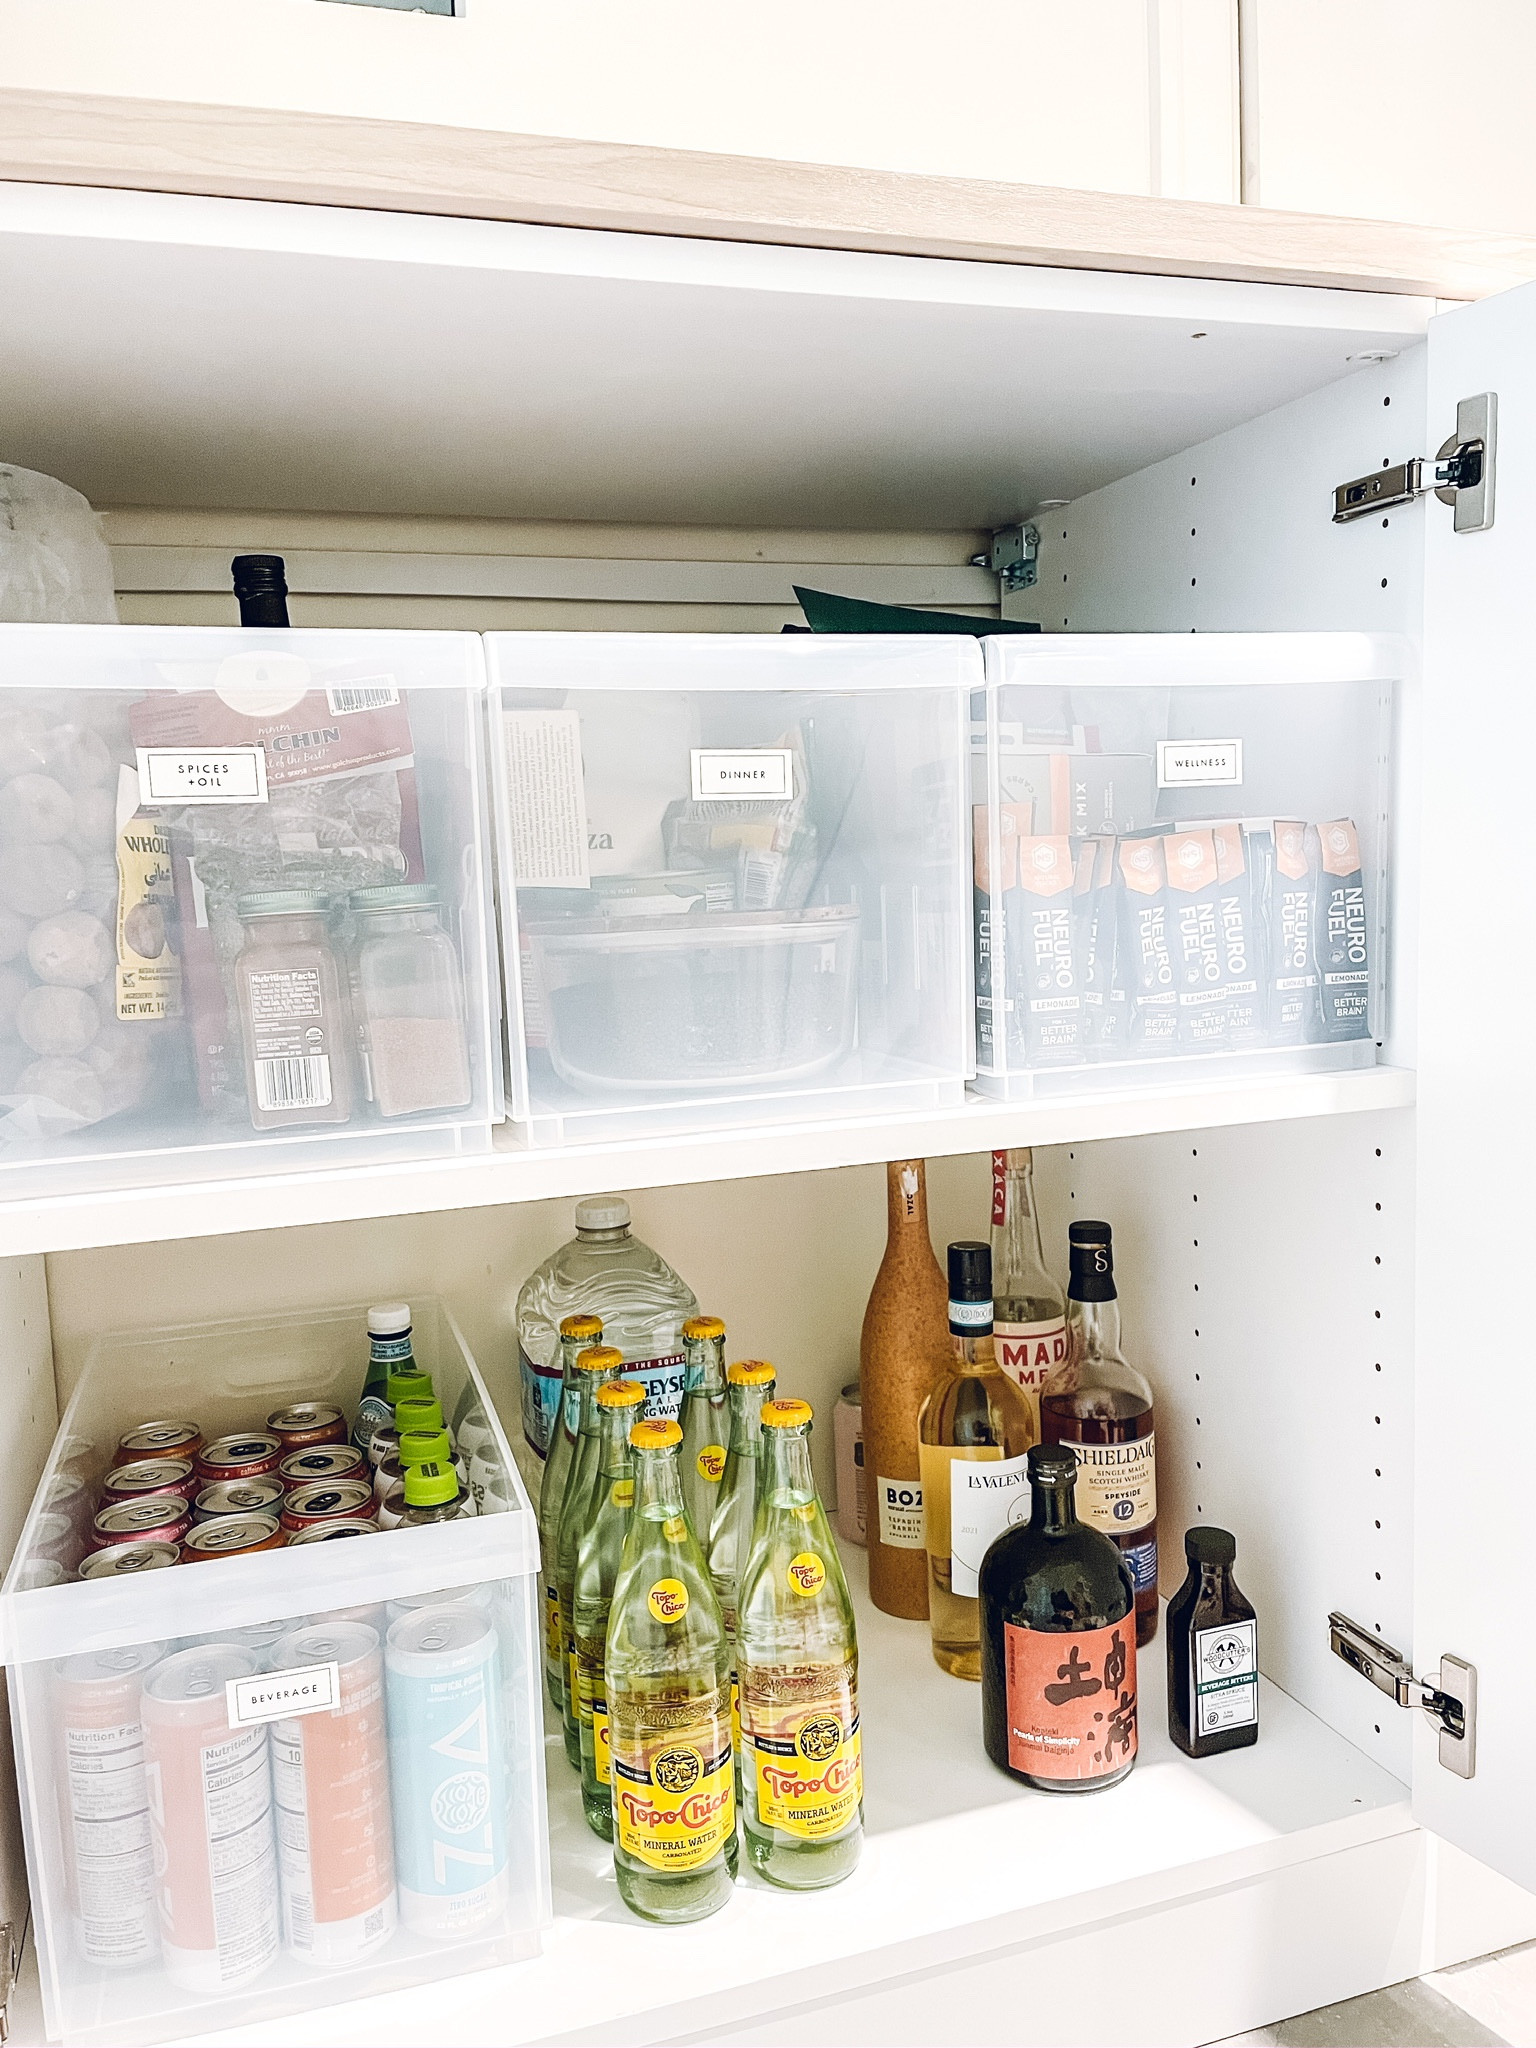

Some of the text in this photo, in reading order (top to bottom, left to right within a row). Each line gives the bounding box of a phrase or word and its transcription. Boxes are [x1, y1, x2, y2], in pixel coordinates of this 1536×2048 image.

[233, 727, 341, 753] LCHIN
[178, 764, 230, 774] SPICES
[1175, 759, 1226, 767] WELLNESS
[188, 777, 222, 787] +OIL
[720, 770, 766, 779] DINNER
[1075, 782, 1087, 817] MIX
[1281, 892, 1295, 947] FUEL
[1328, 889, 1345, 943] FUEL
[1179, 906, 1201, 962] FUEL
[1295, 892, 1308, 968] NEURO
[1346, 888, 1367, 963] NEURO
[1032, 911, 1054, 966] FUEL
[1139, 909, 1155, 965] FUEL
[1197, 903, 1220, 981] NEURO
[1221, 897, 1247, 974] NEURO
[1051, 909, 1073, 988] NEURO
[1152, 906, 1172, 984] NEURO
[251, 971, 317, 983] Nutrition Facts
[1226, 984, 1253, 993] ONADE
[121, 1003, 137, 1014] NET
[139, 1003, 154, 1013] WT.
[1037, 999, 1077, 1009] LEMONADE
[1334, 997, 1367, 1007] BETTER
[1227, 1008, 1253, 1018] TTER
[1041, 1025, 1077, 1035] BETTER
[1145, 1018, 1176, 1028] BETTER
[993, 1155, 1004, 1215] XACA
[1094, 1250, 1108, 1272] S
[1003, 1338, 1064, 1366] MAD
[635, 1361, 652, 1370] THE
[657, 1355, 686, 1366] SOURC
[641, 1374, 686, 1397] GEYSE
[660, 1403, 680, 1415] WAT
[700, 1455, 721, 1466] Topo
[1128, 1464, 1145, 1473] MALT
[968, 1471, 1026, 1488] LA VALENT
[1124, 1471, 1149, 1482] WHISKY
[887, 1488, 922, 1506] BOZ
[1105, 1488, 1141, 1499] SPEYSIDE
[1117, 1503, 1132, 1517] 12
[791, 1565, 816, 1579] Topo
[801, 1575, 823, 1588] Chico
[652, 1591, 678, 1605] Topo
[661, 1601, 686, 1615] Chico
[1202, 1675, 1253, 1692] BEVERAGE BITTERS
[251, 1685, 318, 1704] BEVERAGE
[69, 1732, 115, 1742] Nutrition
[1013, 1727, 1081, 1746] Pearls of Simplicity
[206, 1735, 251, 1760] Nutrition
[71, 1760, 103, 1770] Calories
[207, 1770, 243, 1789] Calories
[763, 1766, 823, 1798] Topo
[622, 1787, 730, 1829] Topo Chico
[788, 1806, 829, 1819] MINERAL
[831, 1793, 854, 1811] WATER
[806, 1811, 843, 1826] CARBONATED
[644, 1839, 686, 1850] MINERAL
[688, 1830, 716, 1846] WATER
[662, 1848, 702, 1858] CARBONATED
